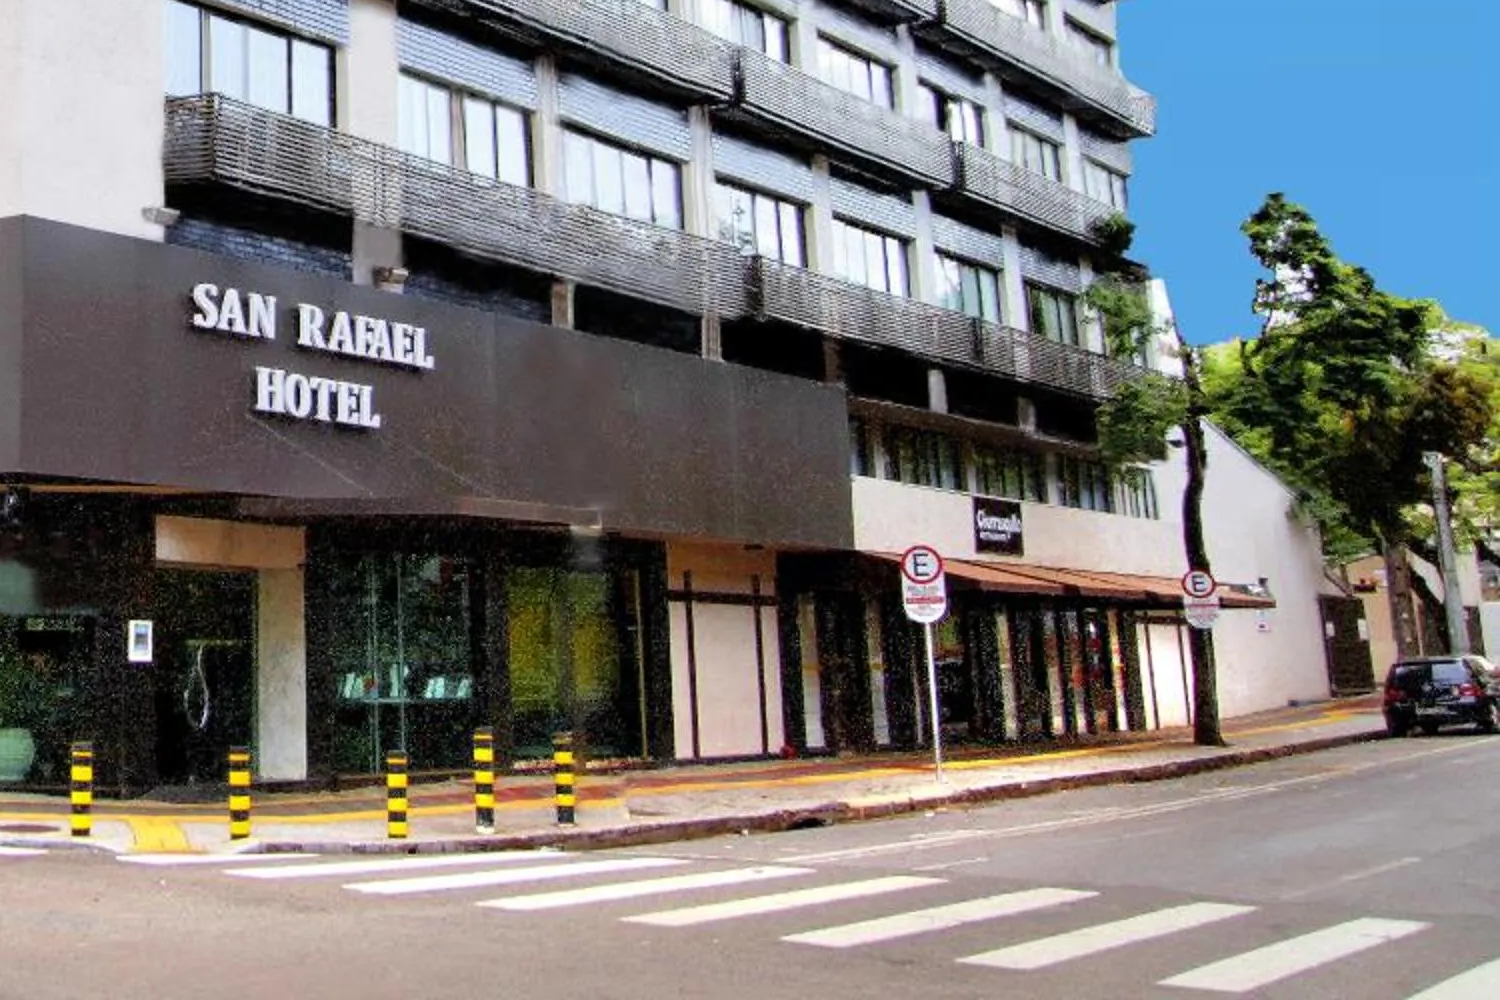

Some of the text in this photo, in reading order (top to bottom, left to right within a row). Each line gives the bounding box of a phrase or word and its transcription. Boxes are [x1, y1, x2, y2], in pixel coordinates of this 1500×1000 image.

[192, 283, 435, 370] SAN RAFAEL
[255, 366, 381, 429] HOTEL
[913, 553, 930, 577] E
[1191, 574, 1206, 593] E
